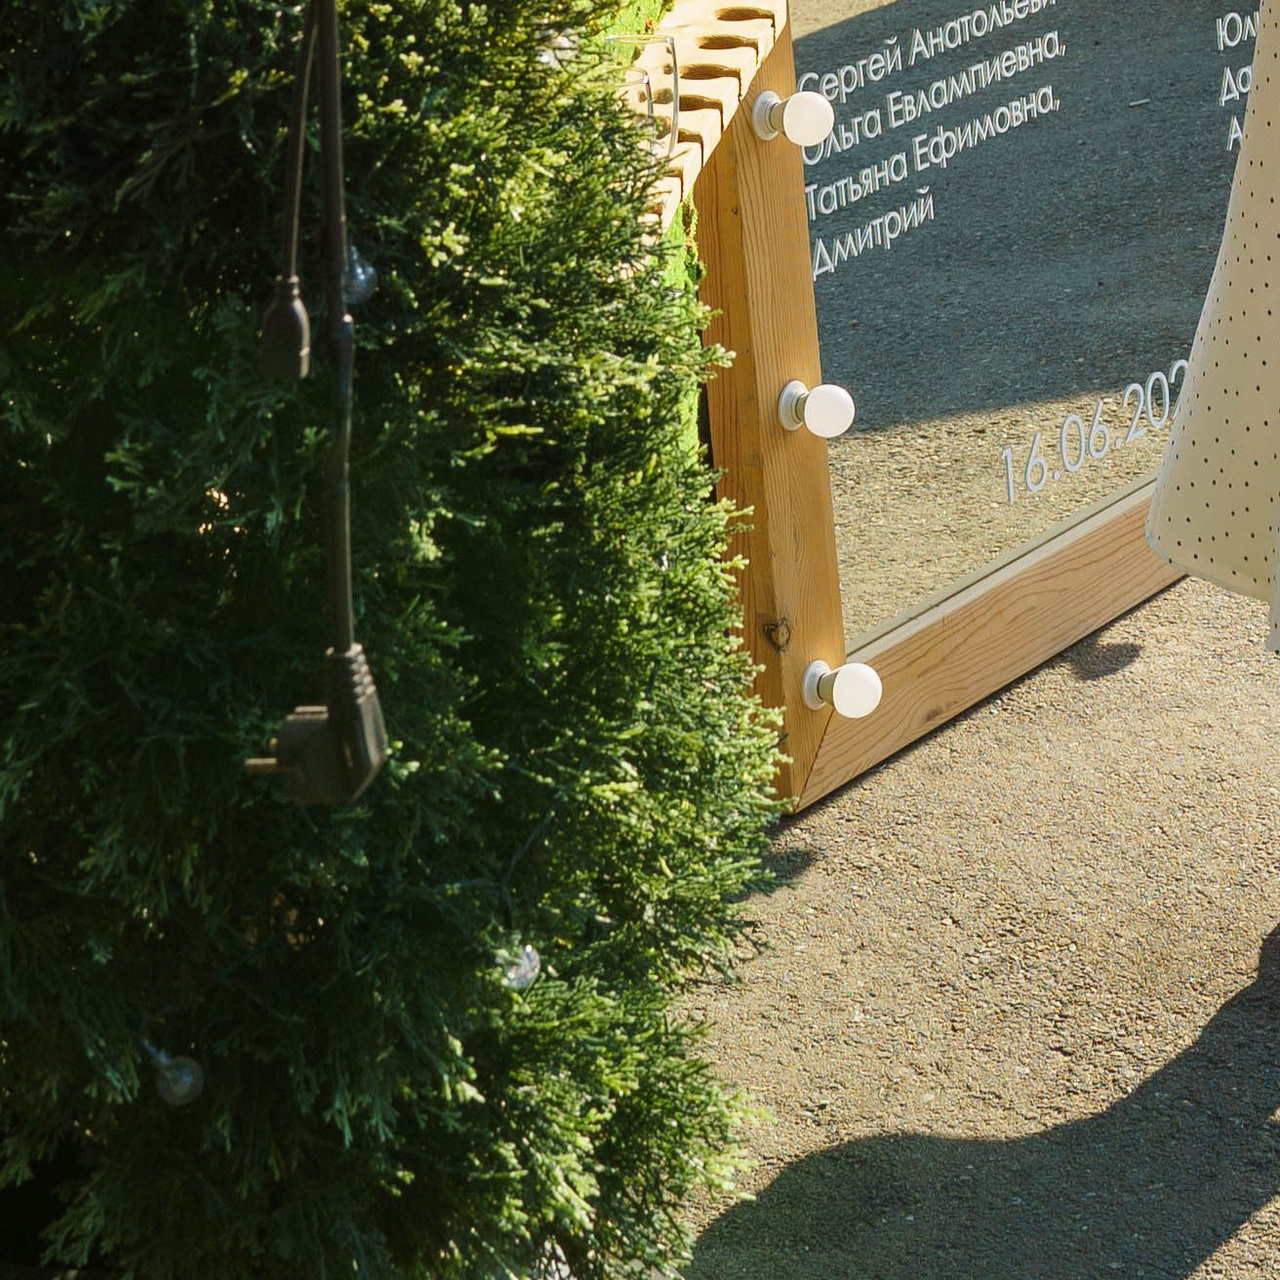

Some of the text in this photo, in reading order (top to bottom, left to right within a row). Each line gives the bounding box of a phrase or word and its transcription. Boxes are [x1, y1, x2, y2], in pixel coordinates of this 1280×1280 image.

[886, 29, 1067, 130] Евлампиевна,
[805, 85, 1061, 222] Татьяна Ефимовна,
[813, 185, 936, 283] Дмитрий
